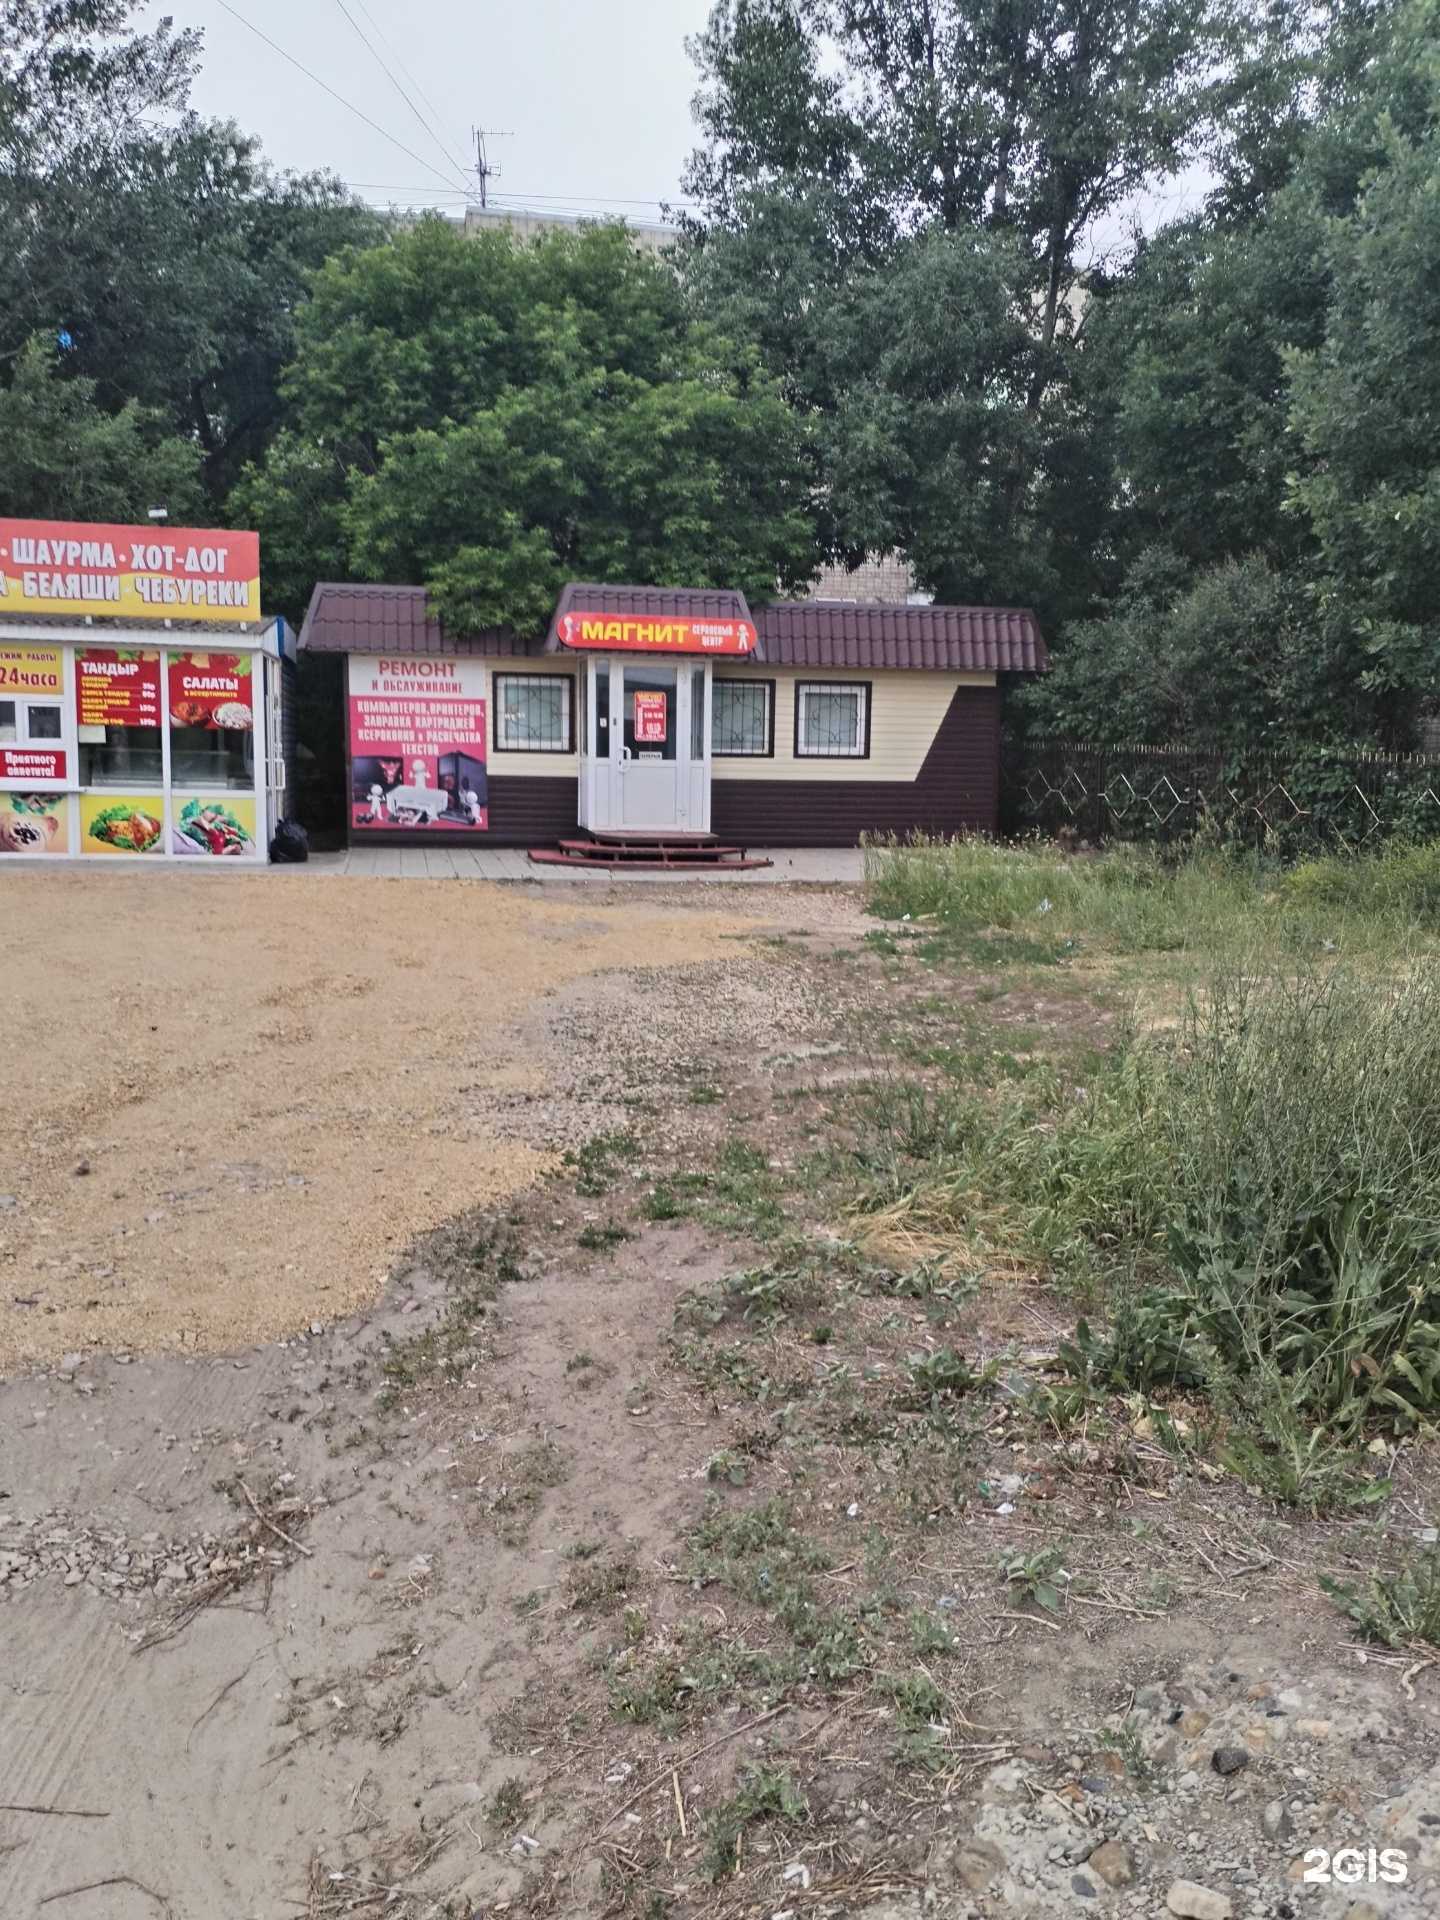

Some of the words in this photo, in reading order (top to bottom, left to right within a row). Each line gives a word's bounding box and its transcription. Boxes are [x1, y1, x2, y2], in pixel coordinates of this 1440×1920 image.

[12, 538, 117, 568] ШАУРМА
[130, 544, 228, 573] ХОТ-ДОГ
[23, 572, 120, 601] БЕЛЯШИ
[135, 577, 249, 606] ЧЕБУРЕКИ
[582, 621, 690, 643] МАГНИТ
[81, 662, 139, 677] ТАНДЫР
[379, 660, 456, 677] РЕМОНТ
[182, 676, 239, 690] САЛАТЫ
[383, 680, 462, 694] ОБСЛУЖИВАНИЕ
[5, 751, 56, 766] Приятного
[7, 765, 55, 777] аппетита!
